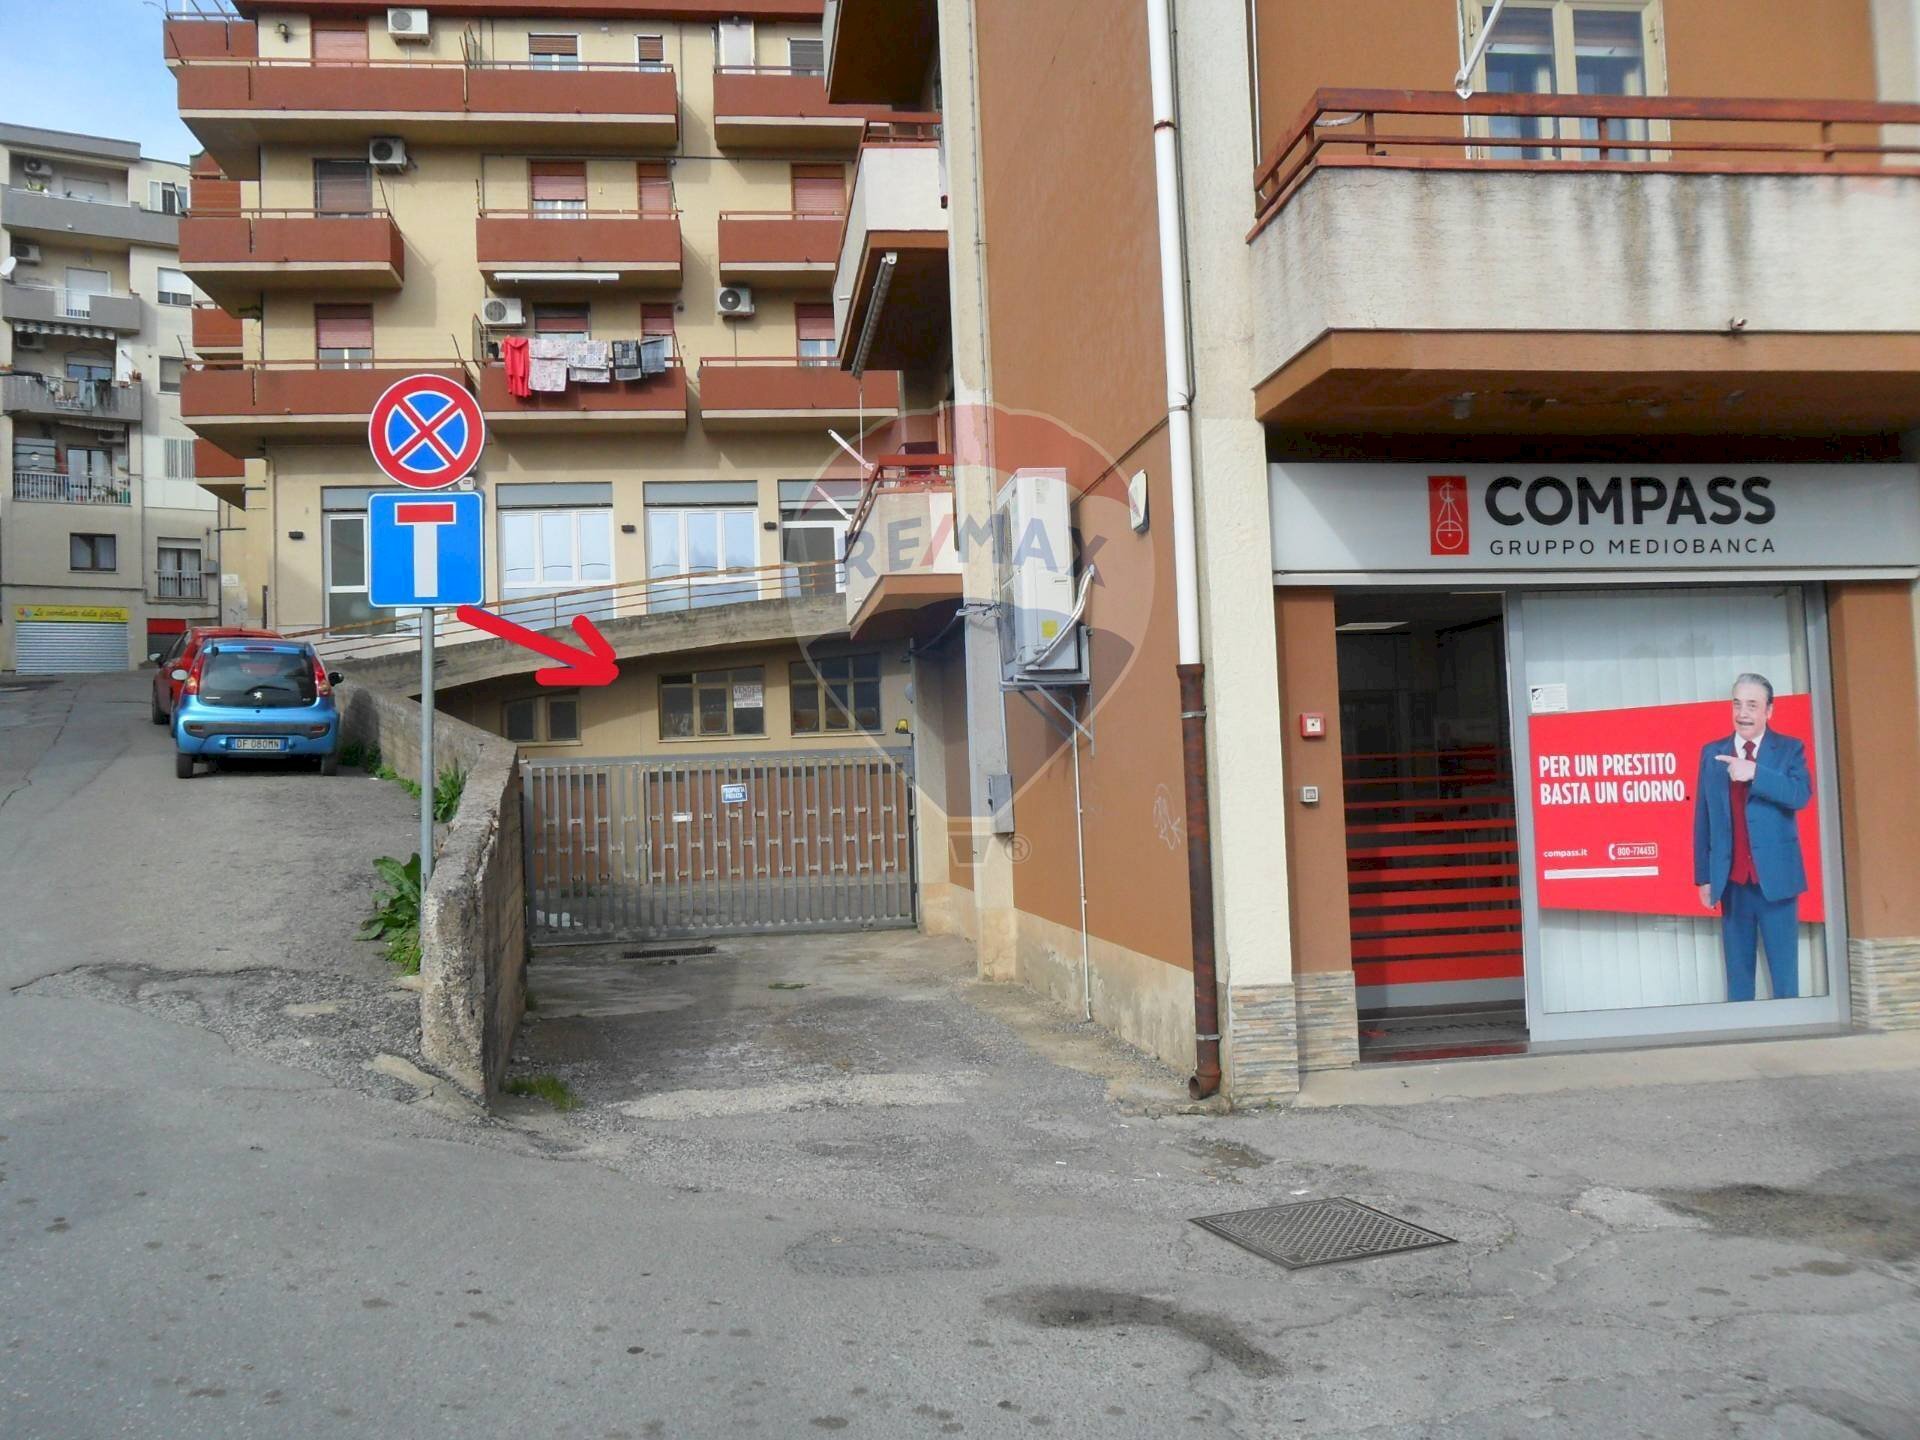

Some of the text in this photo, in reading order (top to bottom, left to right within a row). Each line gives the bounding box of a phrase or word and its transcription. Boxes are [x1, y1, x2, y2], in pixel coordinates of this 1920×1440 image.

[1485, 476, 1775, 526] COMPASS
[1490, 538, 1775, 555] GRUPPO MEDIOBANCA
[1539, 752, 1676, 777] PER UN PRESTITO
[1540, 782, 1591, 805] BASTA
[1594, 781, 1618, 804] UN
[1544, 848, 1588, 858] compass.it
